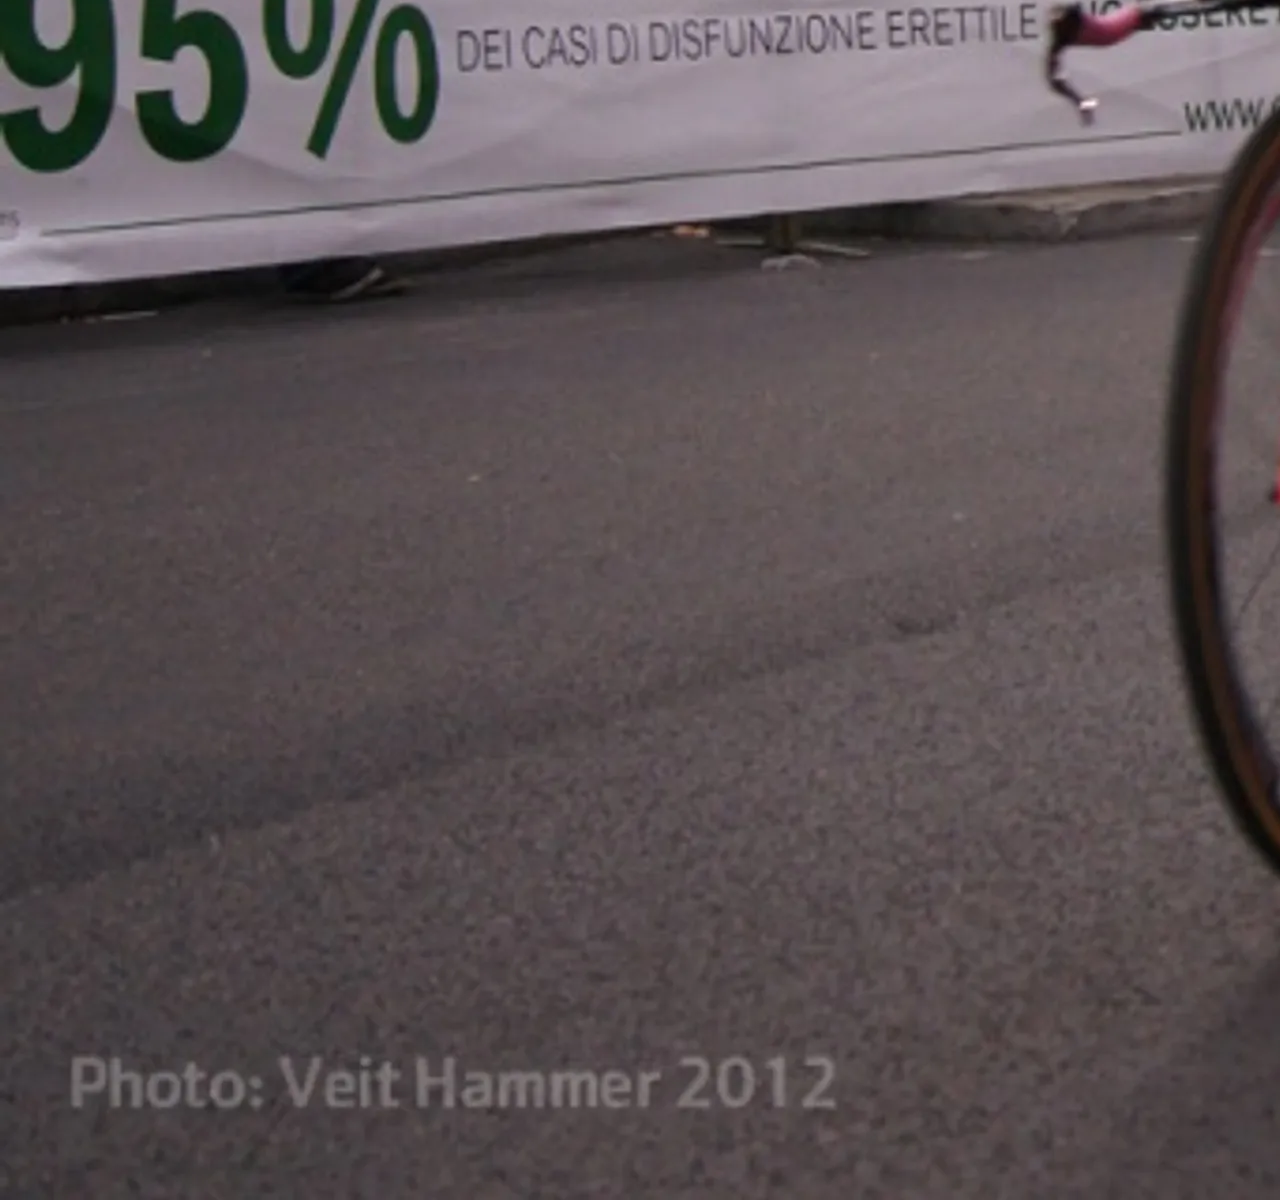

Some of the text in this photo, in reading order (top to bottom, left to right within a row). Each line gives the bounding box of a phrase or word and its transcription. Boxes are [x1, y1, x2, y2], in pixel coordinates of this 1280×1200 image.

[456, 29, 512, 72] DEI
[522, 25, 597, 69] CASI
[607, 22, 639, 65] DI
[649, 10, 877, 62] DISFUNZIONE
[886, 3, 1038, 48] ERETTILE
